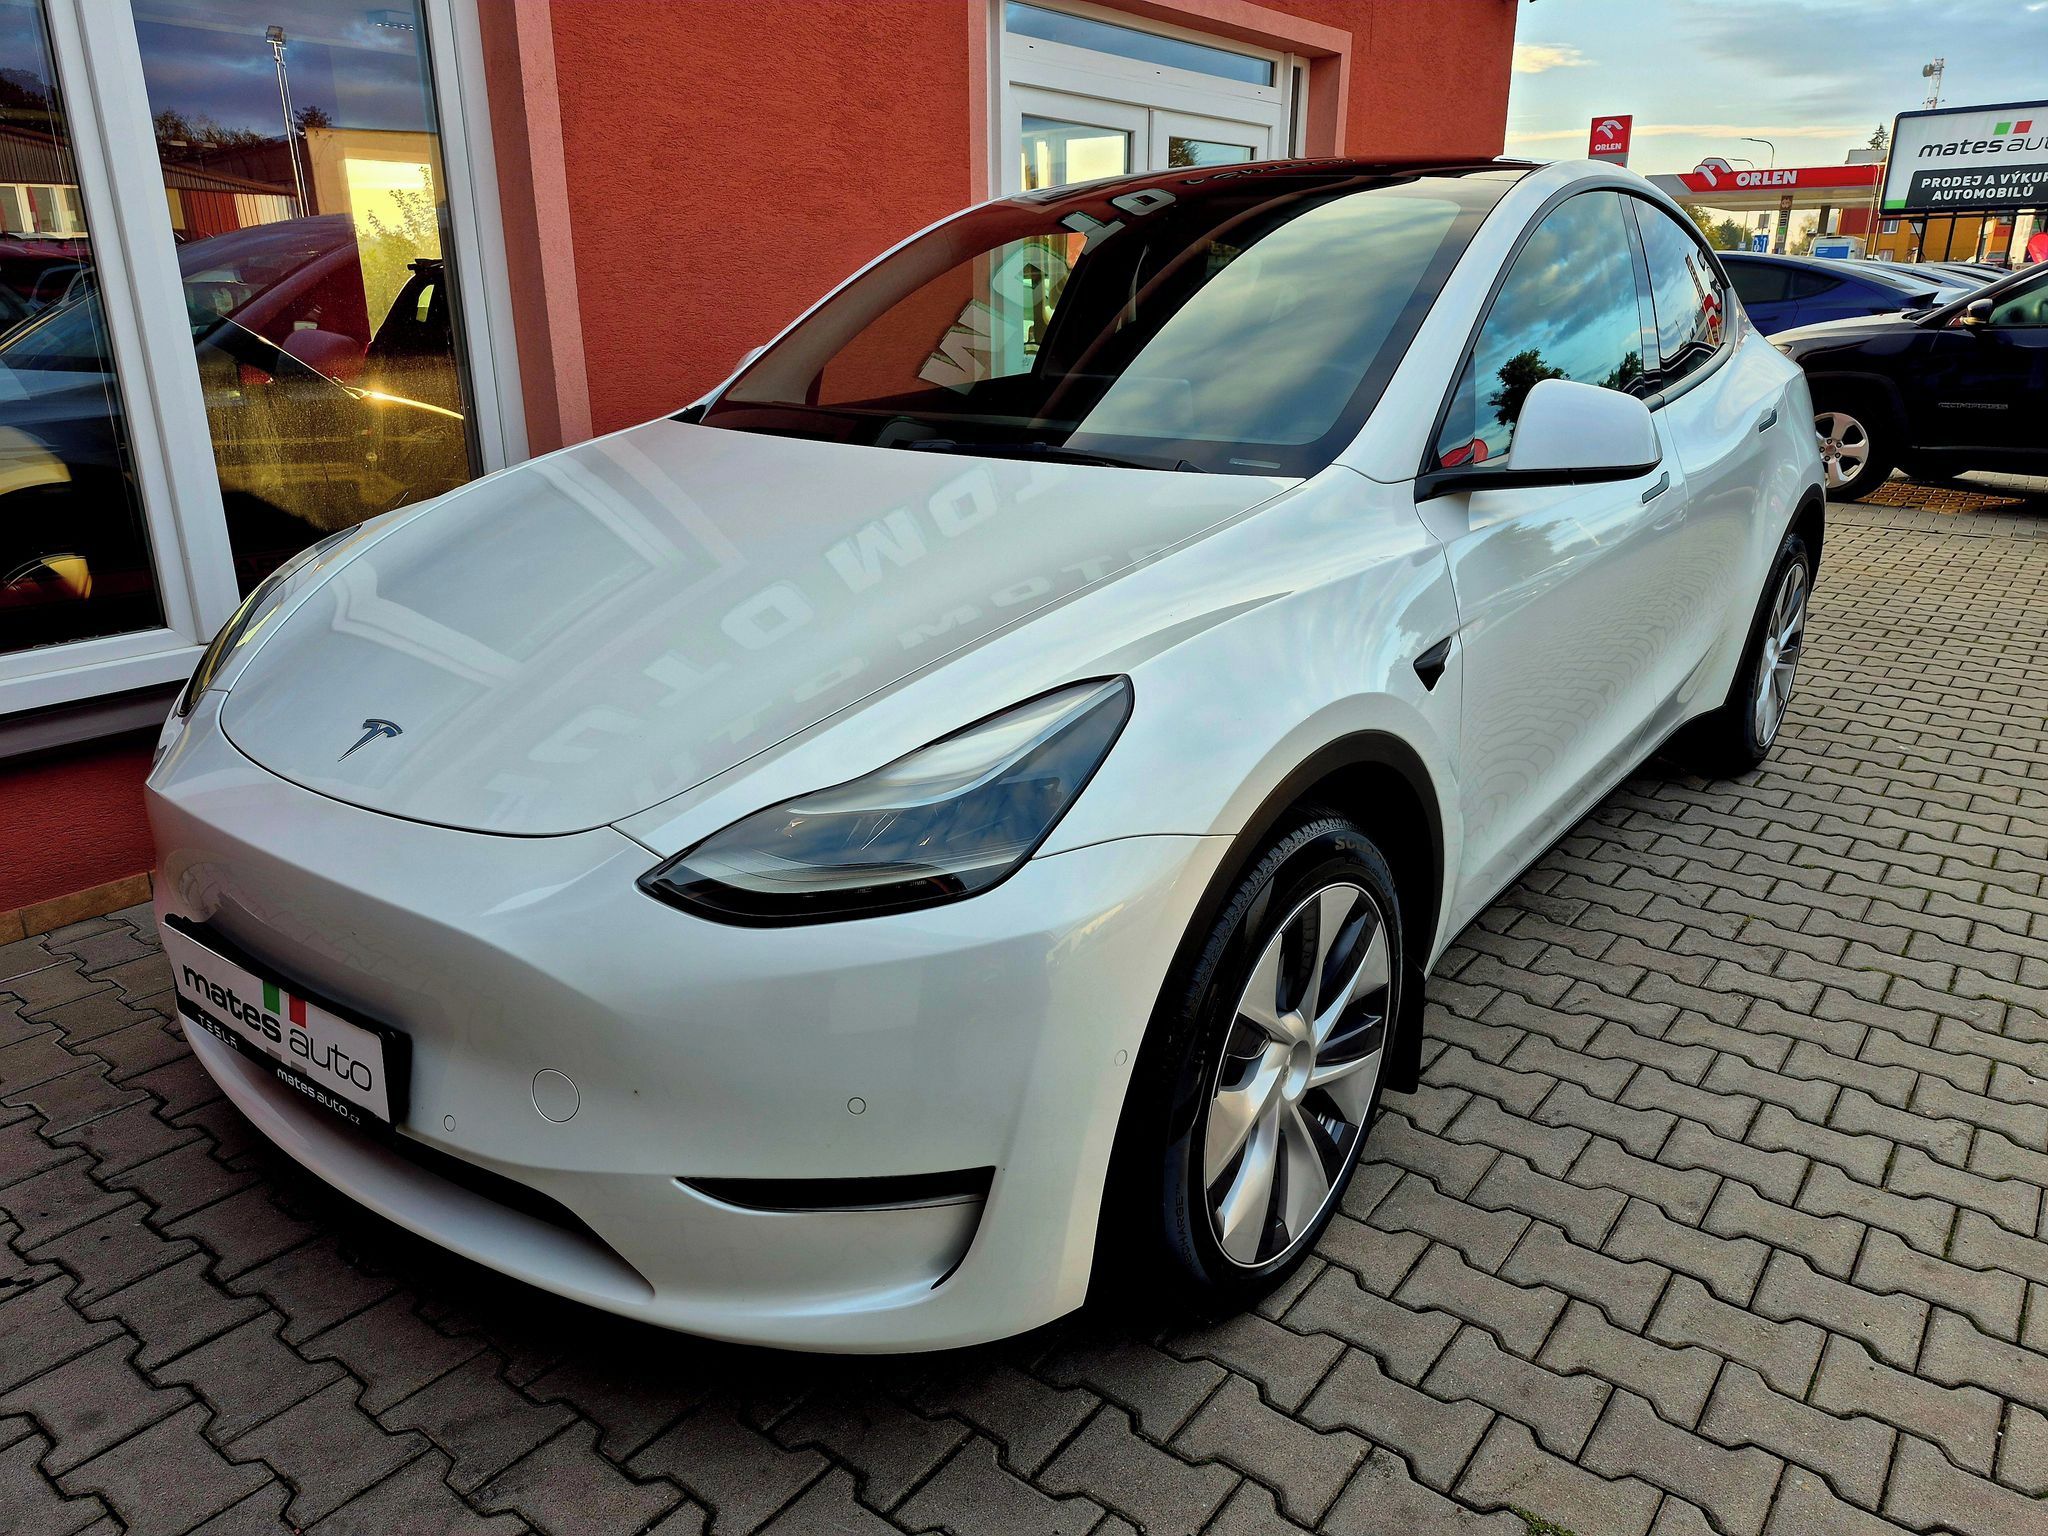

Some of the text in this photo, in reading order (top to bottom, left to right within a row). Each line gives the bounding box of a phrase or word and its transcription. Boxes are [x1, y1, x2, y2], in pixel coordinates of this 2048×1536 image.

[1594, 142, 1622, 152] ORLEN
[1918, 138, 2005, 158] mates
[1735, 170, 1798, 187] ORLEN
[1921, 175, 1983, 189] PRODEJ
[1984, 174, 1996, 186] A
[1932, 183, 2034, 201] AUTOMOBILŮ
[182, 963, 373, 1092] mates auto
